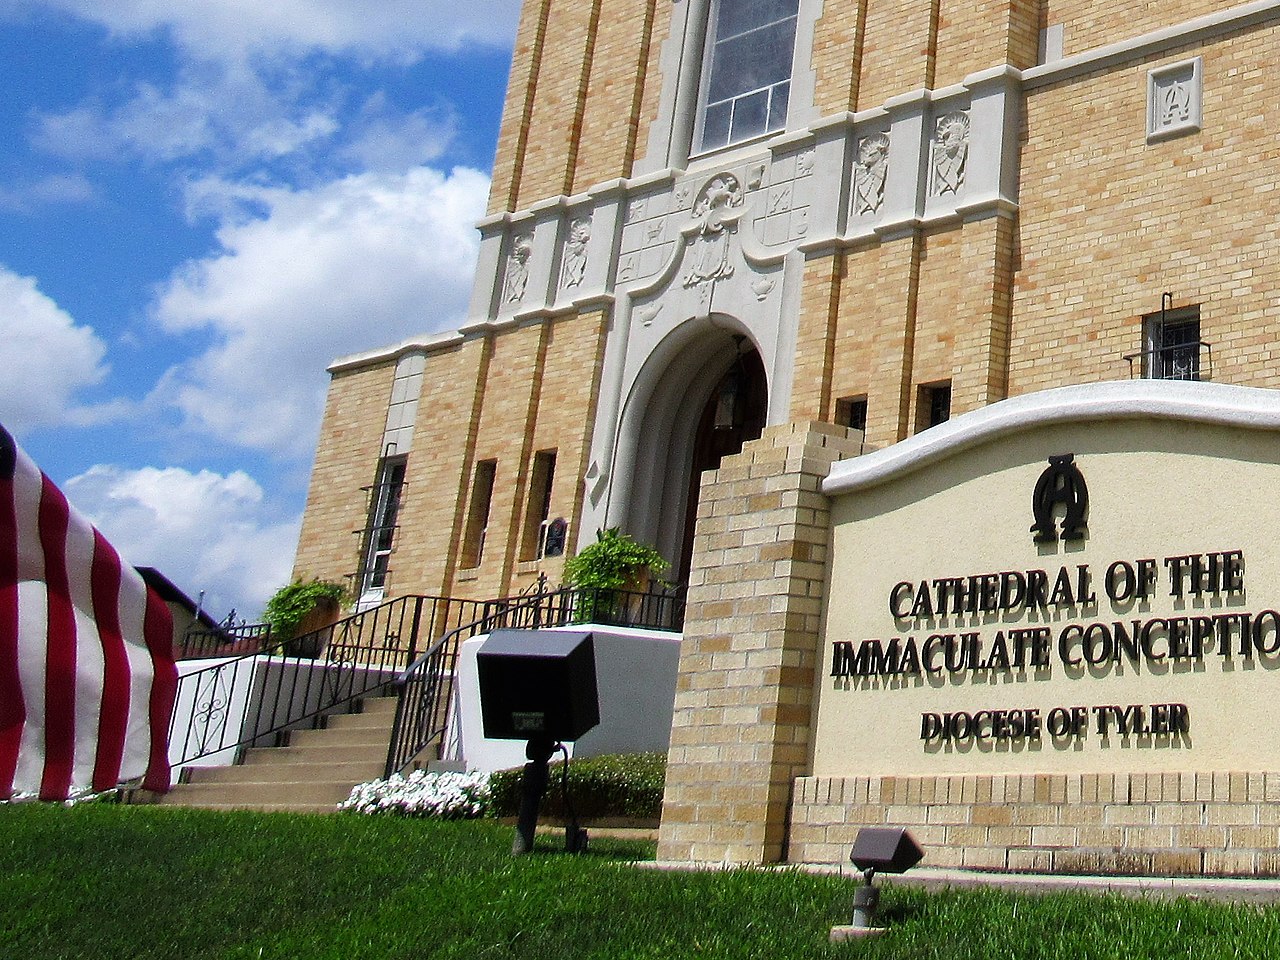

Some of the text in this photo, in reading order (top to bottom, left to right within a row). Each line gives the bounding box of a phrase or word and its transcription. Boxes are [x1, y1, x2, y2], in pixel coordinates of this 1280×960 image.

[890, 550, 1244, 619] CATHEDRAL OF THE
[830, 626, 1051, 678] IMMACULATE
[920, 703, 1191, 741] DIOCESE OF TYLER
